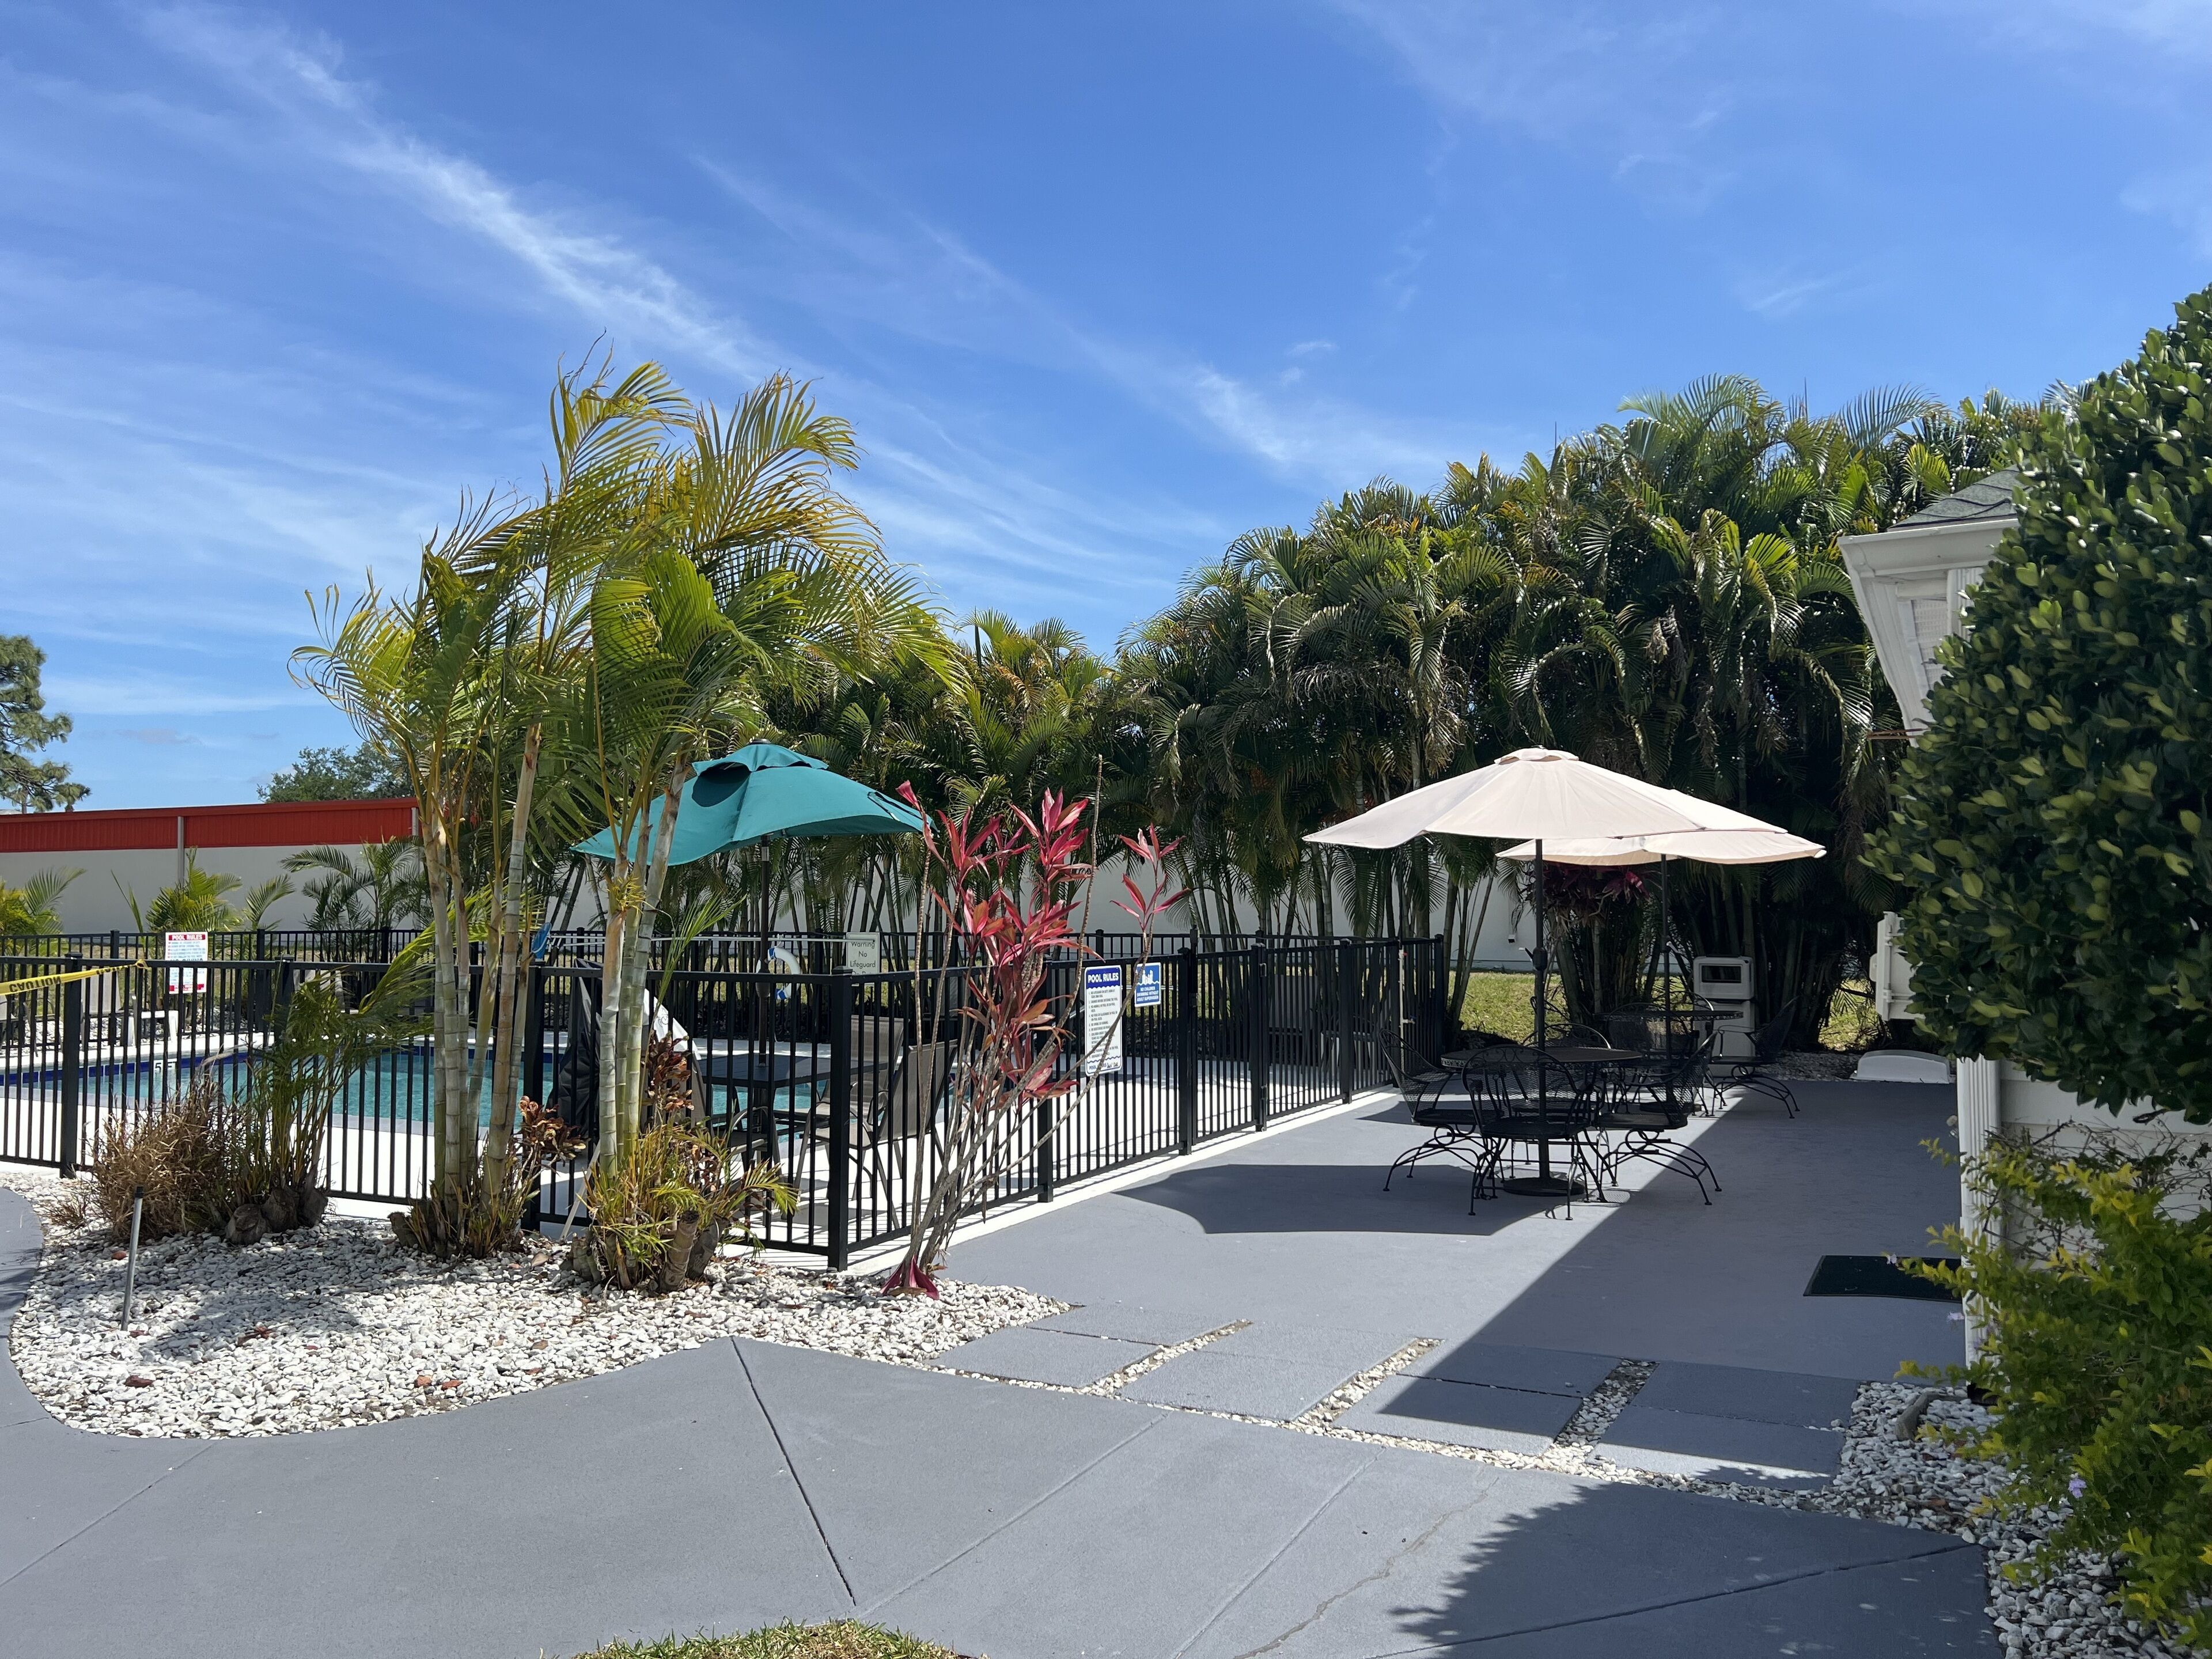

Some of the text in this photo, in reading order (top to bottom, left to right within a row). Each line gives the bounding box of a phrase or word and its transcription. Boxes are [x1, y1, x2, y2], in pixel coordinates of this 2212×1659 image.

[851, 941, 875, 949] Warning
[850, 960, 876, 969] Lifeguard
[1088, 972, 1119, 983] POOL RULES
